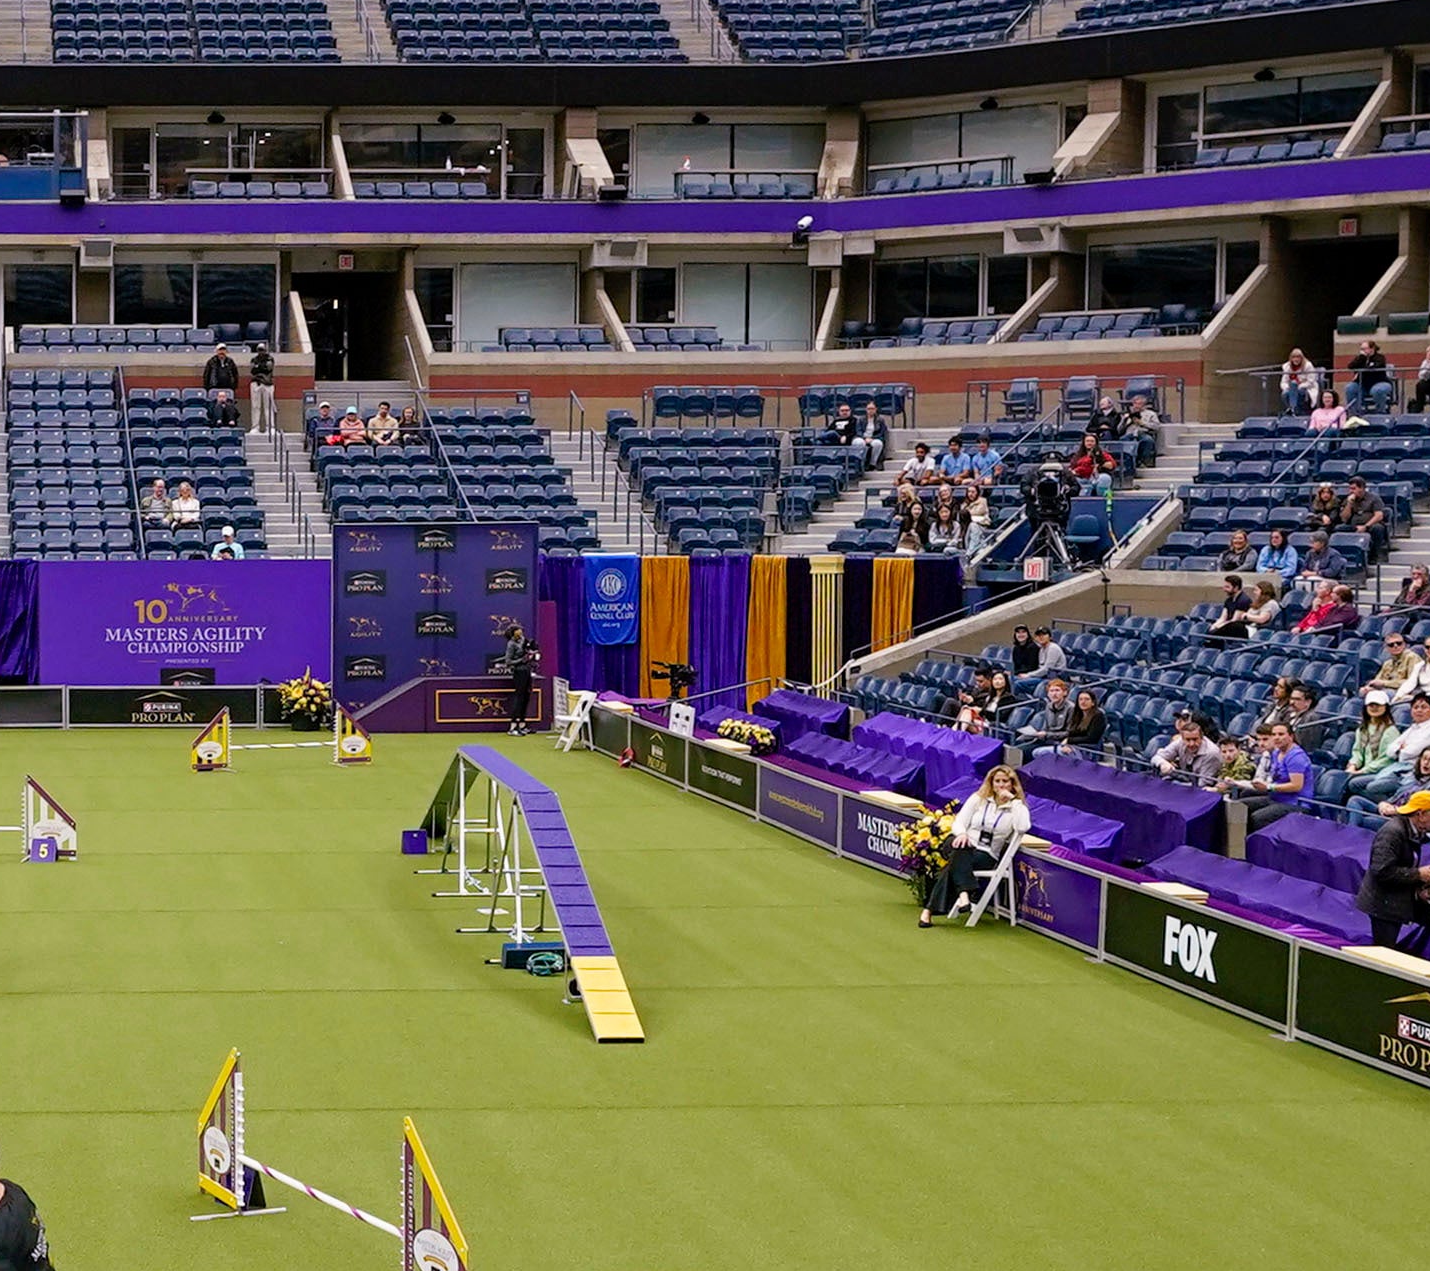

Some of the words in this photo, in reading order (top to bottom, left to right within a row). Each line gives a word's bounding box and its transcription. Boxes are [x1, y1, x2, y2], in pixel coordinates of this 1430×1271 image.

[590, 602, 634, 612] AMERICAN
[105, 628, 188, 642] MASTERS
[192, 627, 266, 641] AGILITY
[127, 642, 244, 654] CHAMPIONSHIP
[131, 712, 159, 723] PRO
[160, 712, 196, 723] PLAN
[39, 843, 49, 859] 5
[1163, 914, 1218, 984] FOX
[1379, 1034, 1418, 1067] PRO
